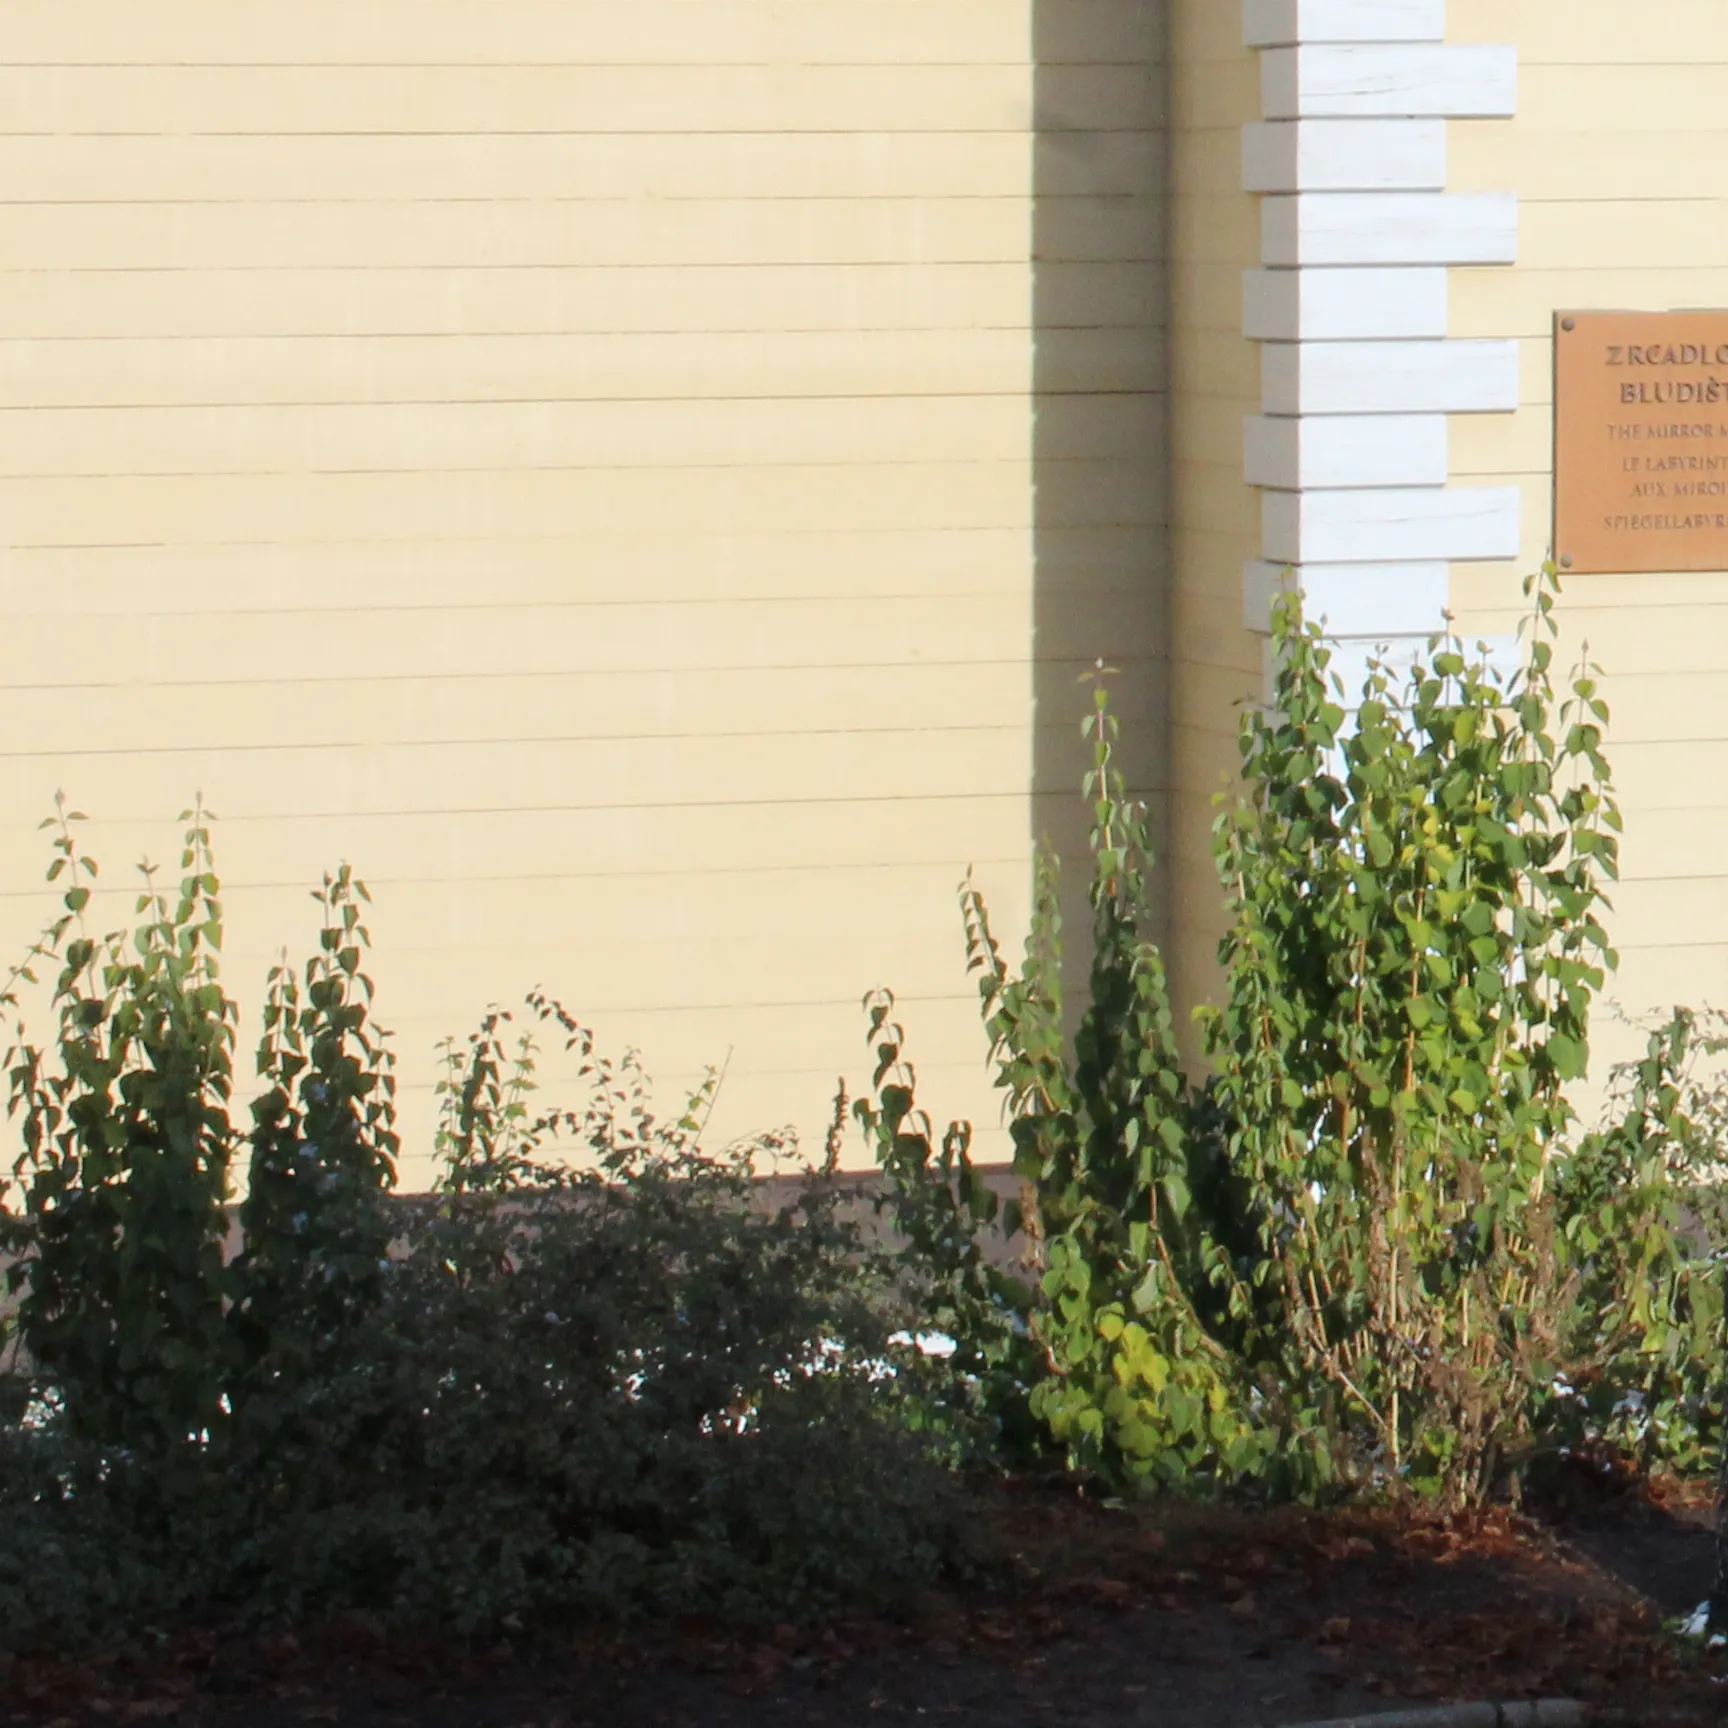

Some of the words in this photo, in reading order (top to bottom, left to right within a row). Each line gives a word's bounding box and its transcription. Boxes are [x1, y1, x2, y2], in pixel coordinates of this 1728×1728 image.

[1607, 424, 1640, 439] THE
[1647, 424, 1713, 438] MIRROR
[1631, 482, 1666, 497] AUX
